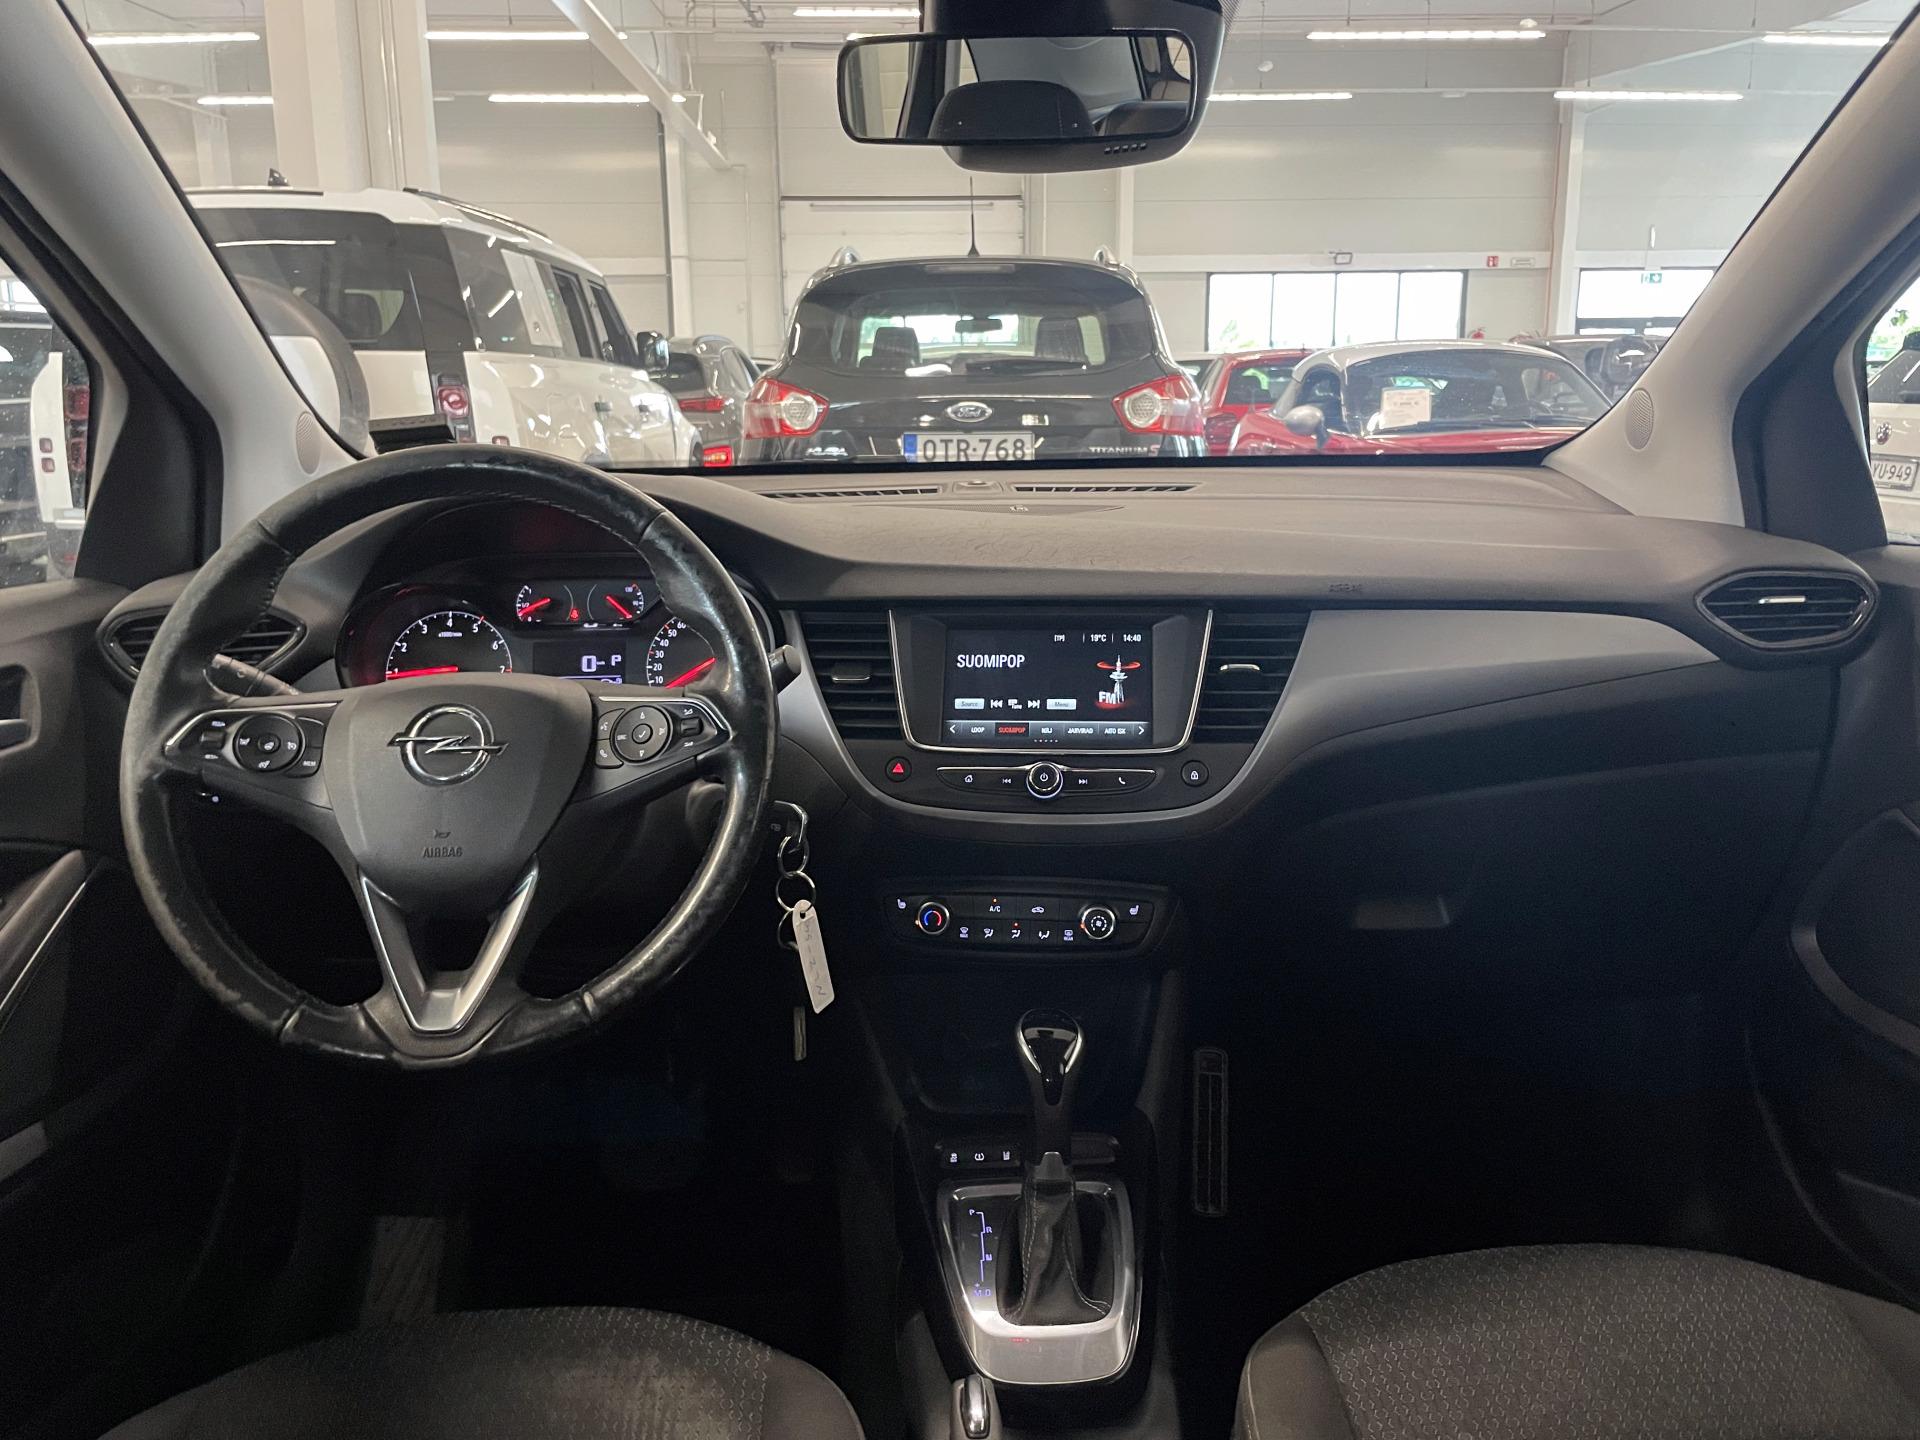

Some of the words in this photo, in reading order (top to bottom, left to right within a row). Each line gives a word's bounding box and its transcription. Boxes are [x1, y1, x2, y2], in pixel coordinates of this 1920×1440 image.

[958, 407, 982, 418] Ford
[1088, 446, 1148, 454] TITANIUM
[446, 619, 453, 628] 4
[422, 624, 428, 634] 3
[472, 624, 479, 633] 5
[667, 629, 677, 637] 50
[1090, 634, 1107, 642] 19°C
[1123, 634, 1142, 642] 14:40
[492, 642, 499, 650] 6
[660, 639, 669, 647] 40
[401, 643, 407, 652] 2
[655, 650, 664, 658] 30
[611, 654, 622, 666] P
[956, 654, 1025, 668] SUOMIPOP
[499, 666, 505, 674] 7
[653, 663, 662, 671] 20
[655, 676, 664, 684] 10
[1098, 691, 1116, 704] FM
[422, 847, 464, 858] AIRBAG
[989, 905, 1001, 913] A/C
[986, 1226, 993, 1234] R
